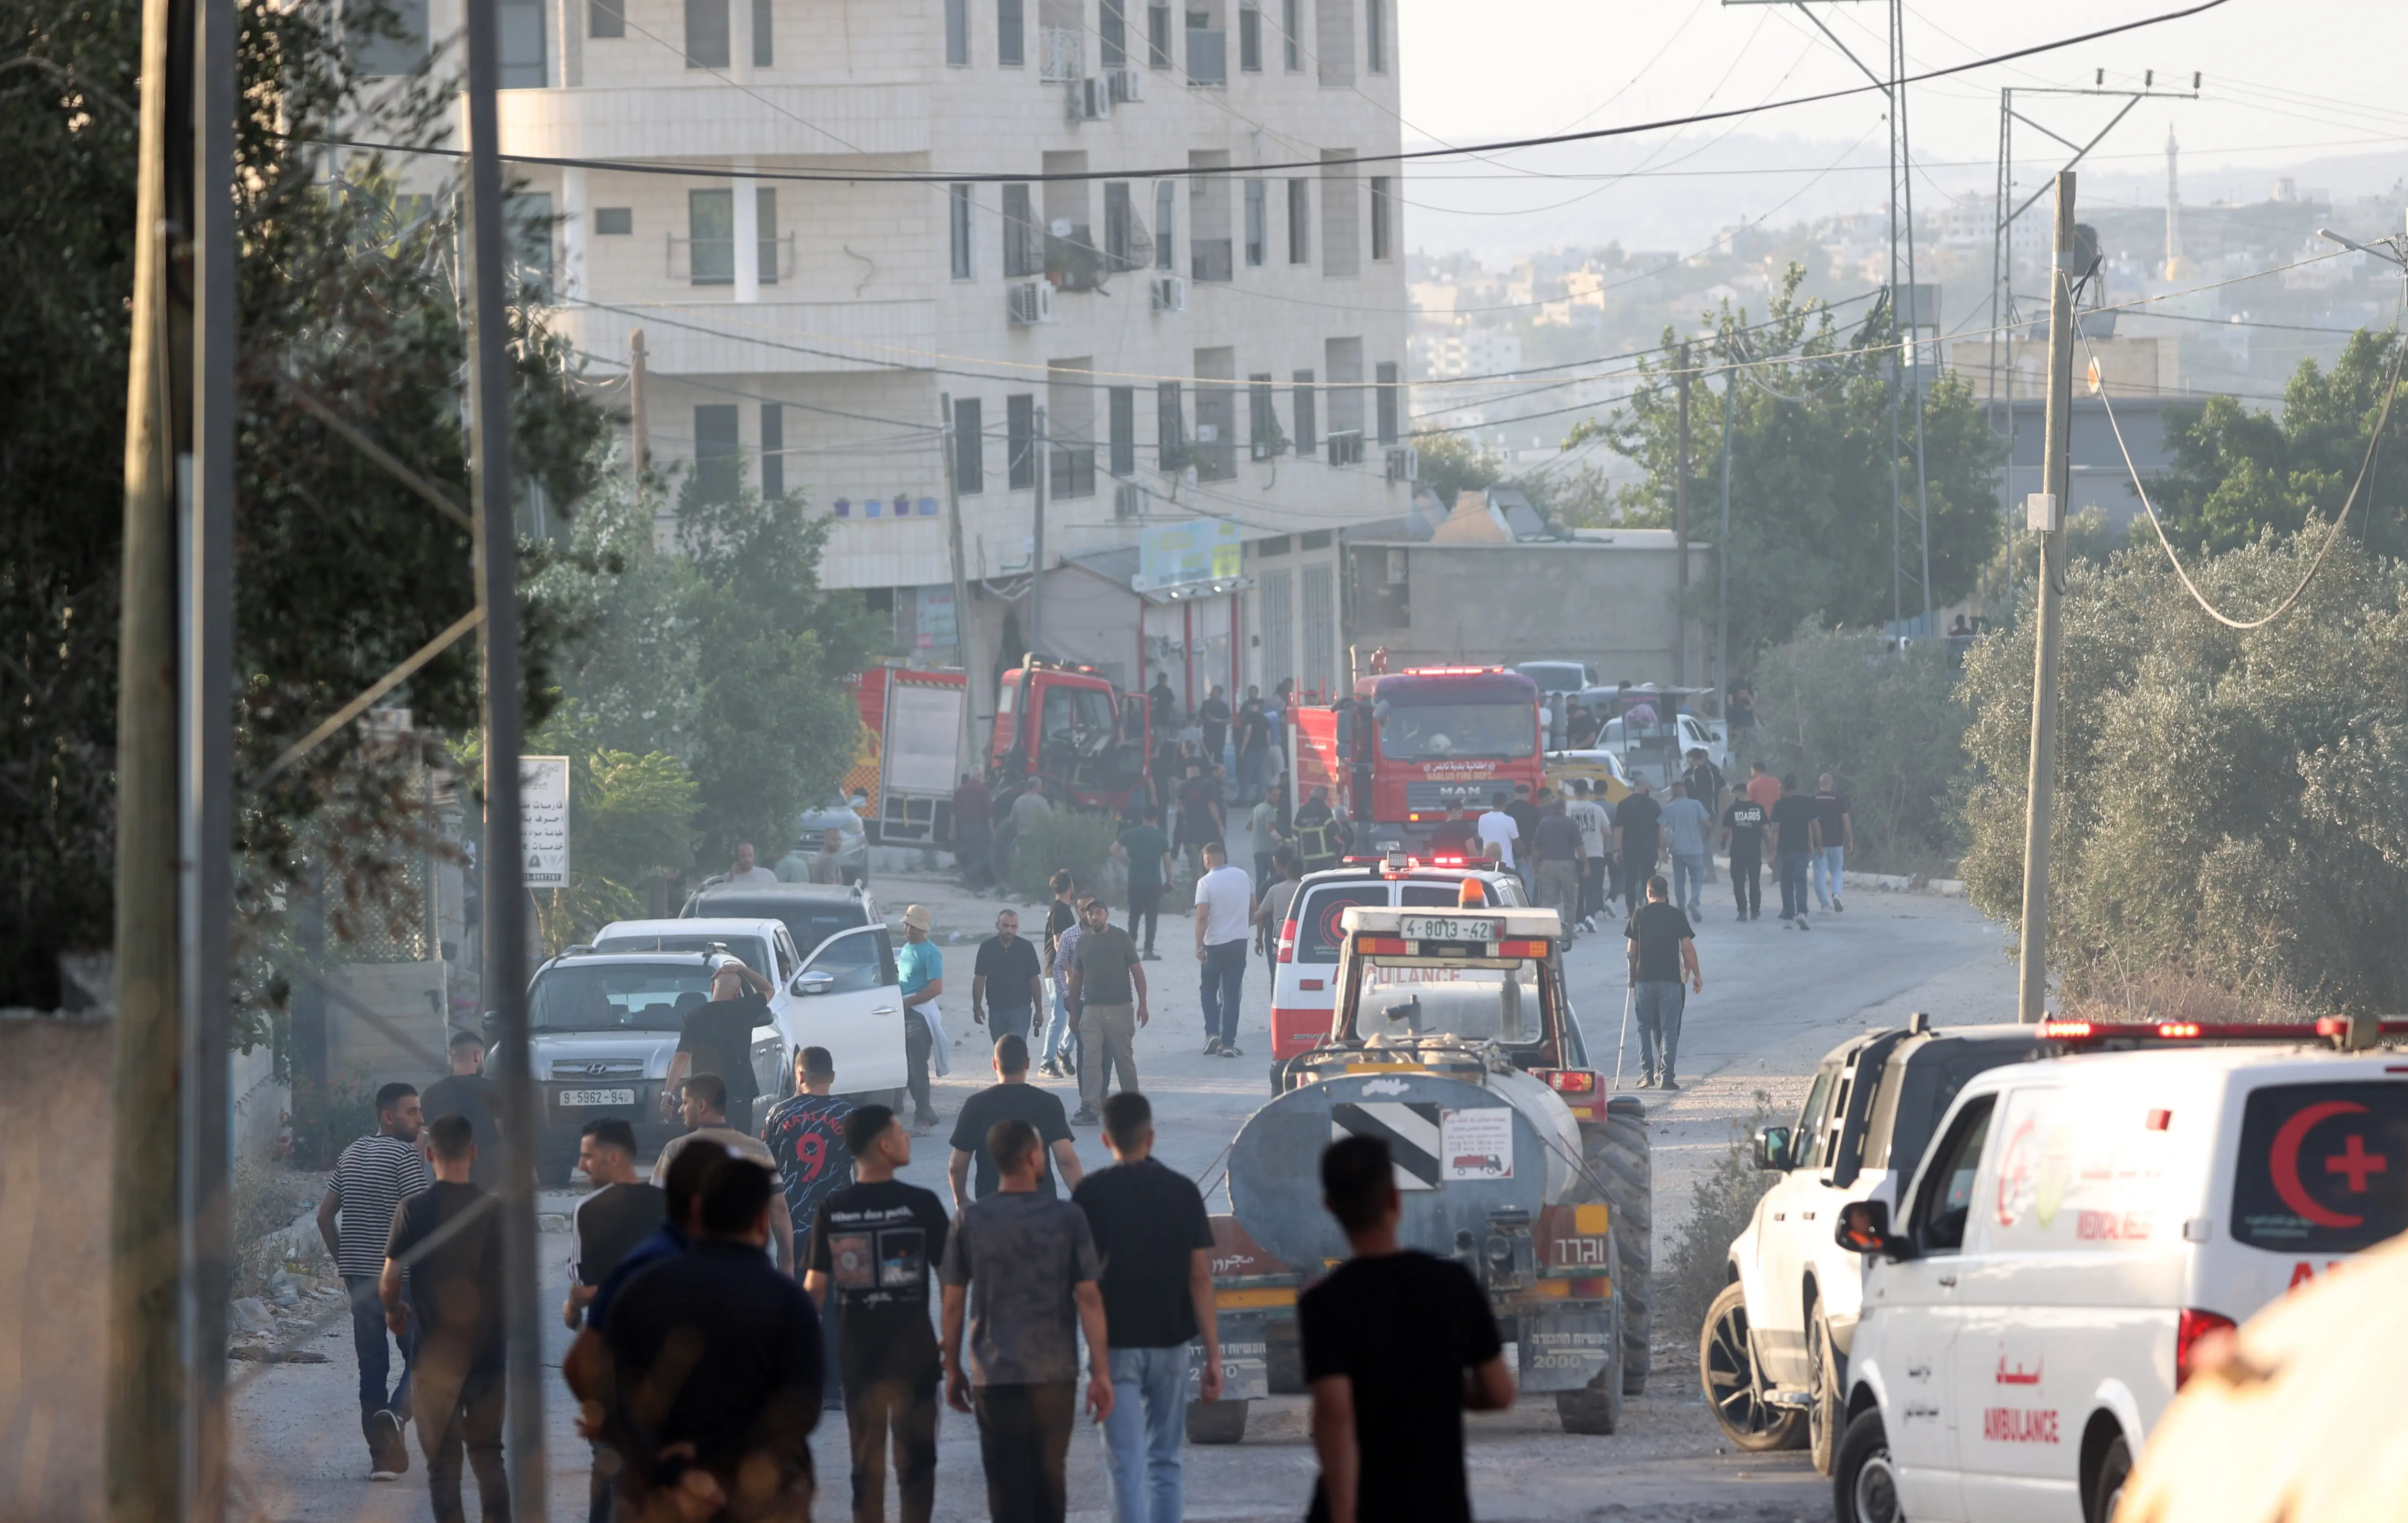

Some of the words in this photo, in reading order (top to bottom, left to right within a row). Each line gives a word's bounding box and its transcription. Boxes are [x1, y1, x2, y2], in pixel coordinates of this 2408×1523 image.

[1457, 771, 1472, 780] FIRE
[1474, 770, 1494, 780] DEPT.
[1440, 787, 1480, 795] MAN
[533, 801, 562, 810] قارمات
[529, 829, 542, 838] مواد
[545, 827, 563, 838] طباعة
[782, 1111, 844, 1135] HAALAND
[795, 1132, 826, 1182] 9
[1212, 1254, 1254, 1273] مجرور
[1533, 1355, 1581, 1369] 2000
[1189, 1365, 1237, 1381] 20
[1984, 1407, 2059, 1444] AMBULANCE
